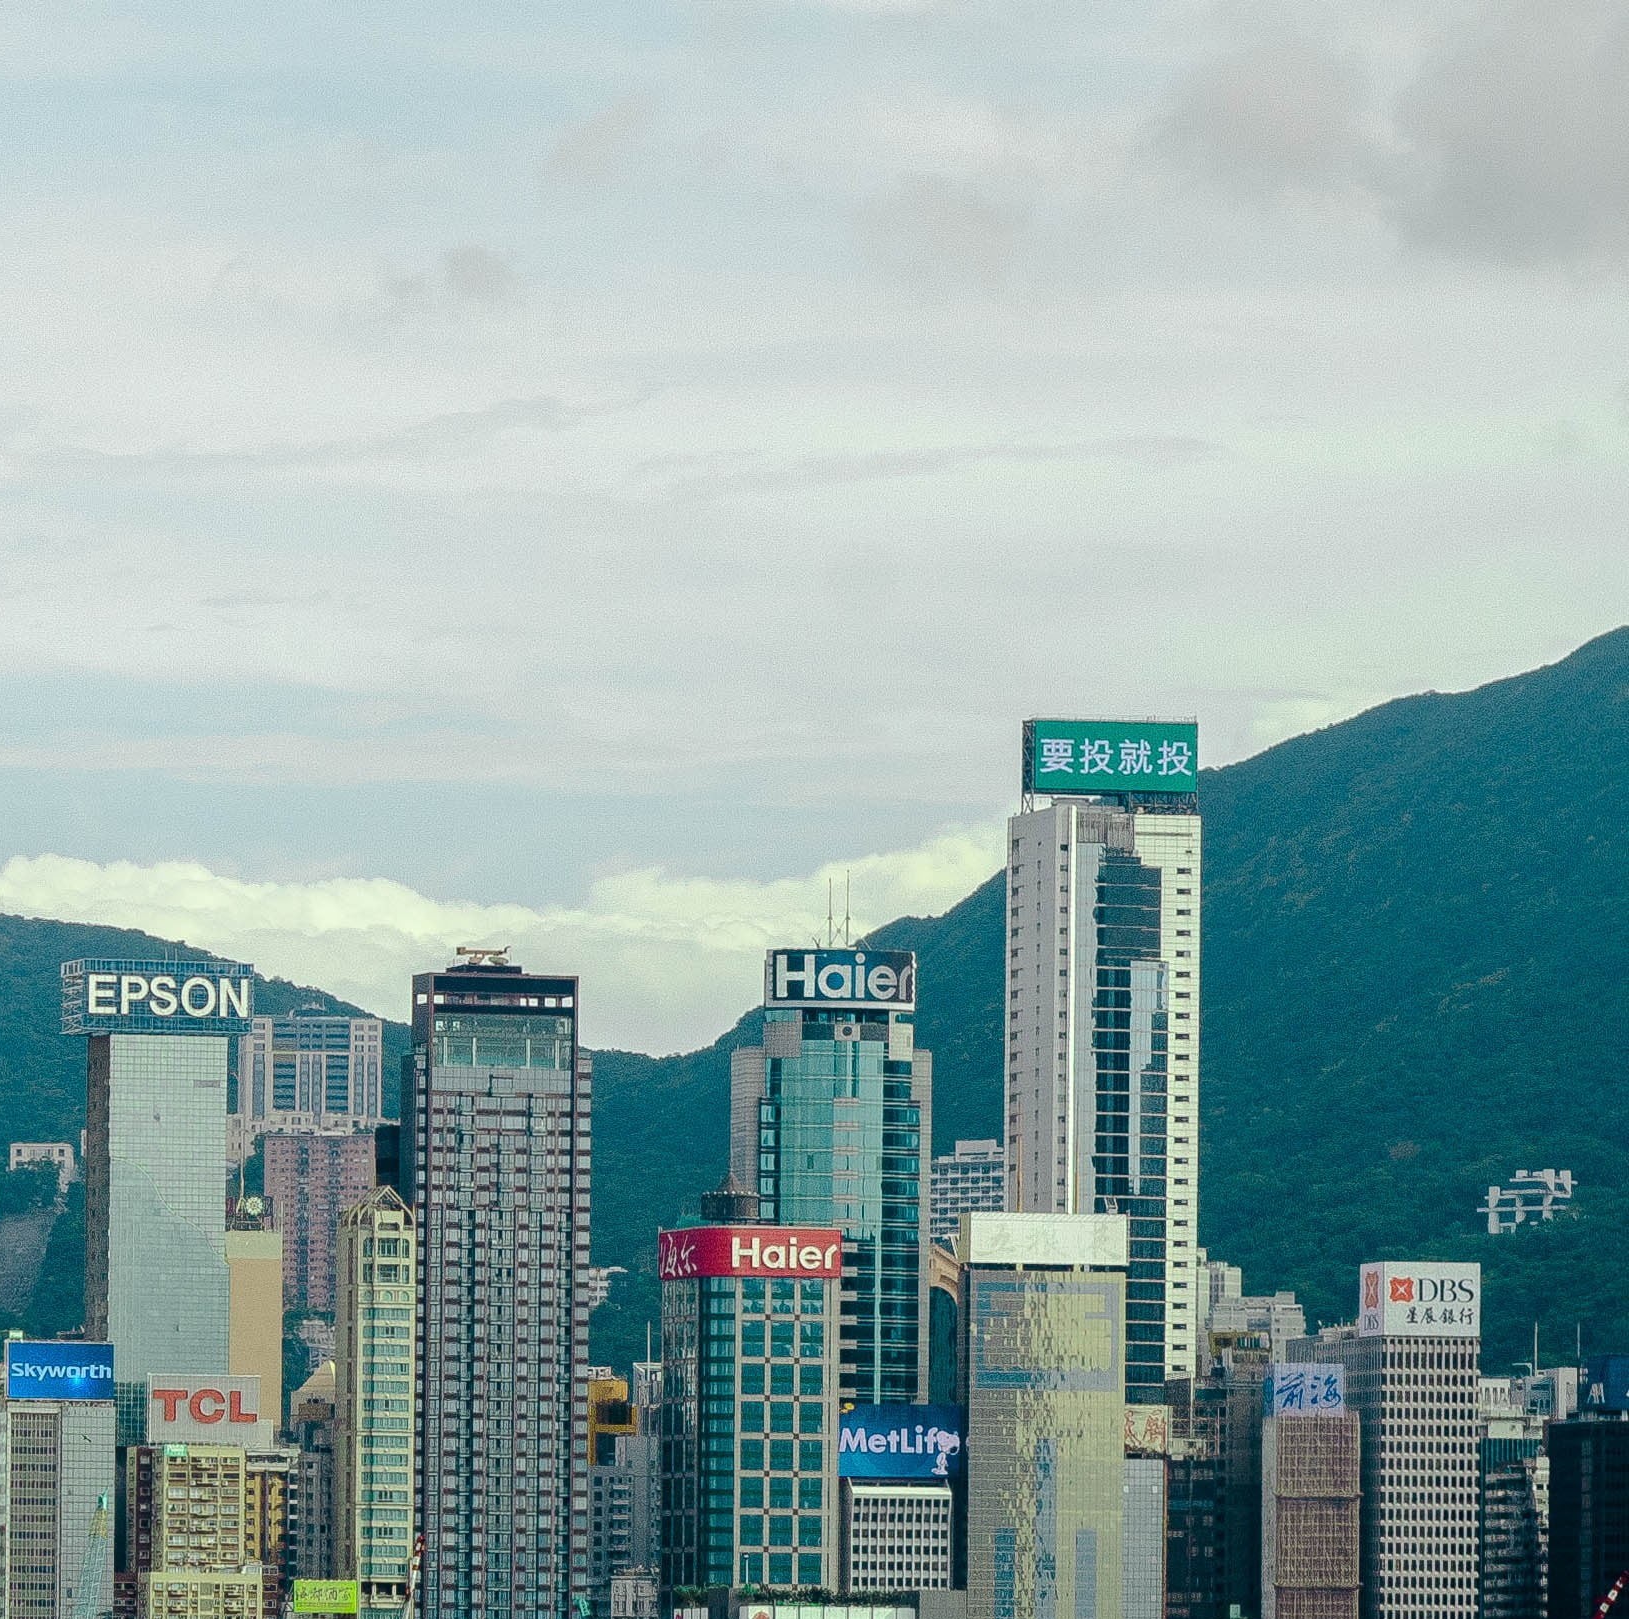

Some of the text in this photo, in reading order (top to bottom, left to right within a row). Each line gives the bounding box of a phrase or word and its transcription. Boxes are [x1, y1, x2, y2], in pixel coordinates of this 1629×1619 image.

[1039, 737, 1193, 776] 要投就投
[775, 951, 913, 1001] Haier
[87, 973, 250, 1018] EPSON
[730, 1235, 838, 1271] Haier
[1418, 1278, 1475, 1302] DBS
[10, 1362, 113, 1382] Skyworth
[152, 1388, 258, 1425] TCL
[838, 1424, 940, 1455] MetLif
